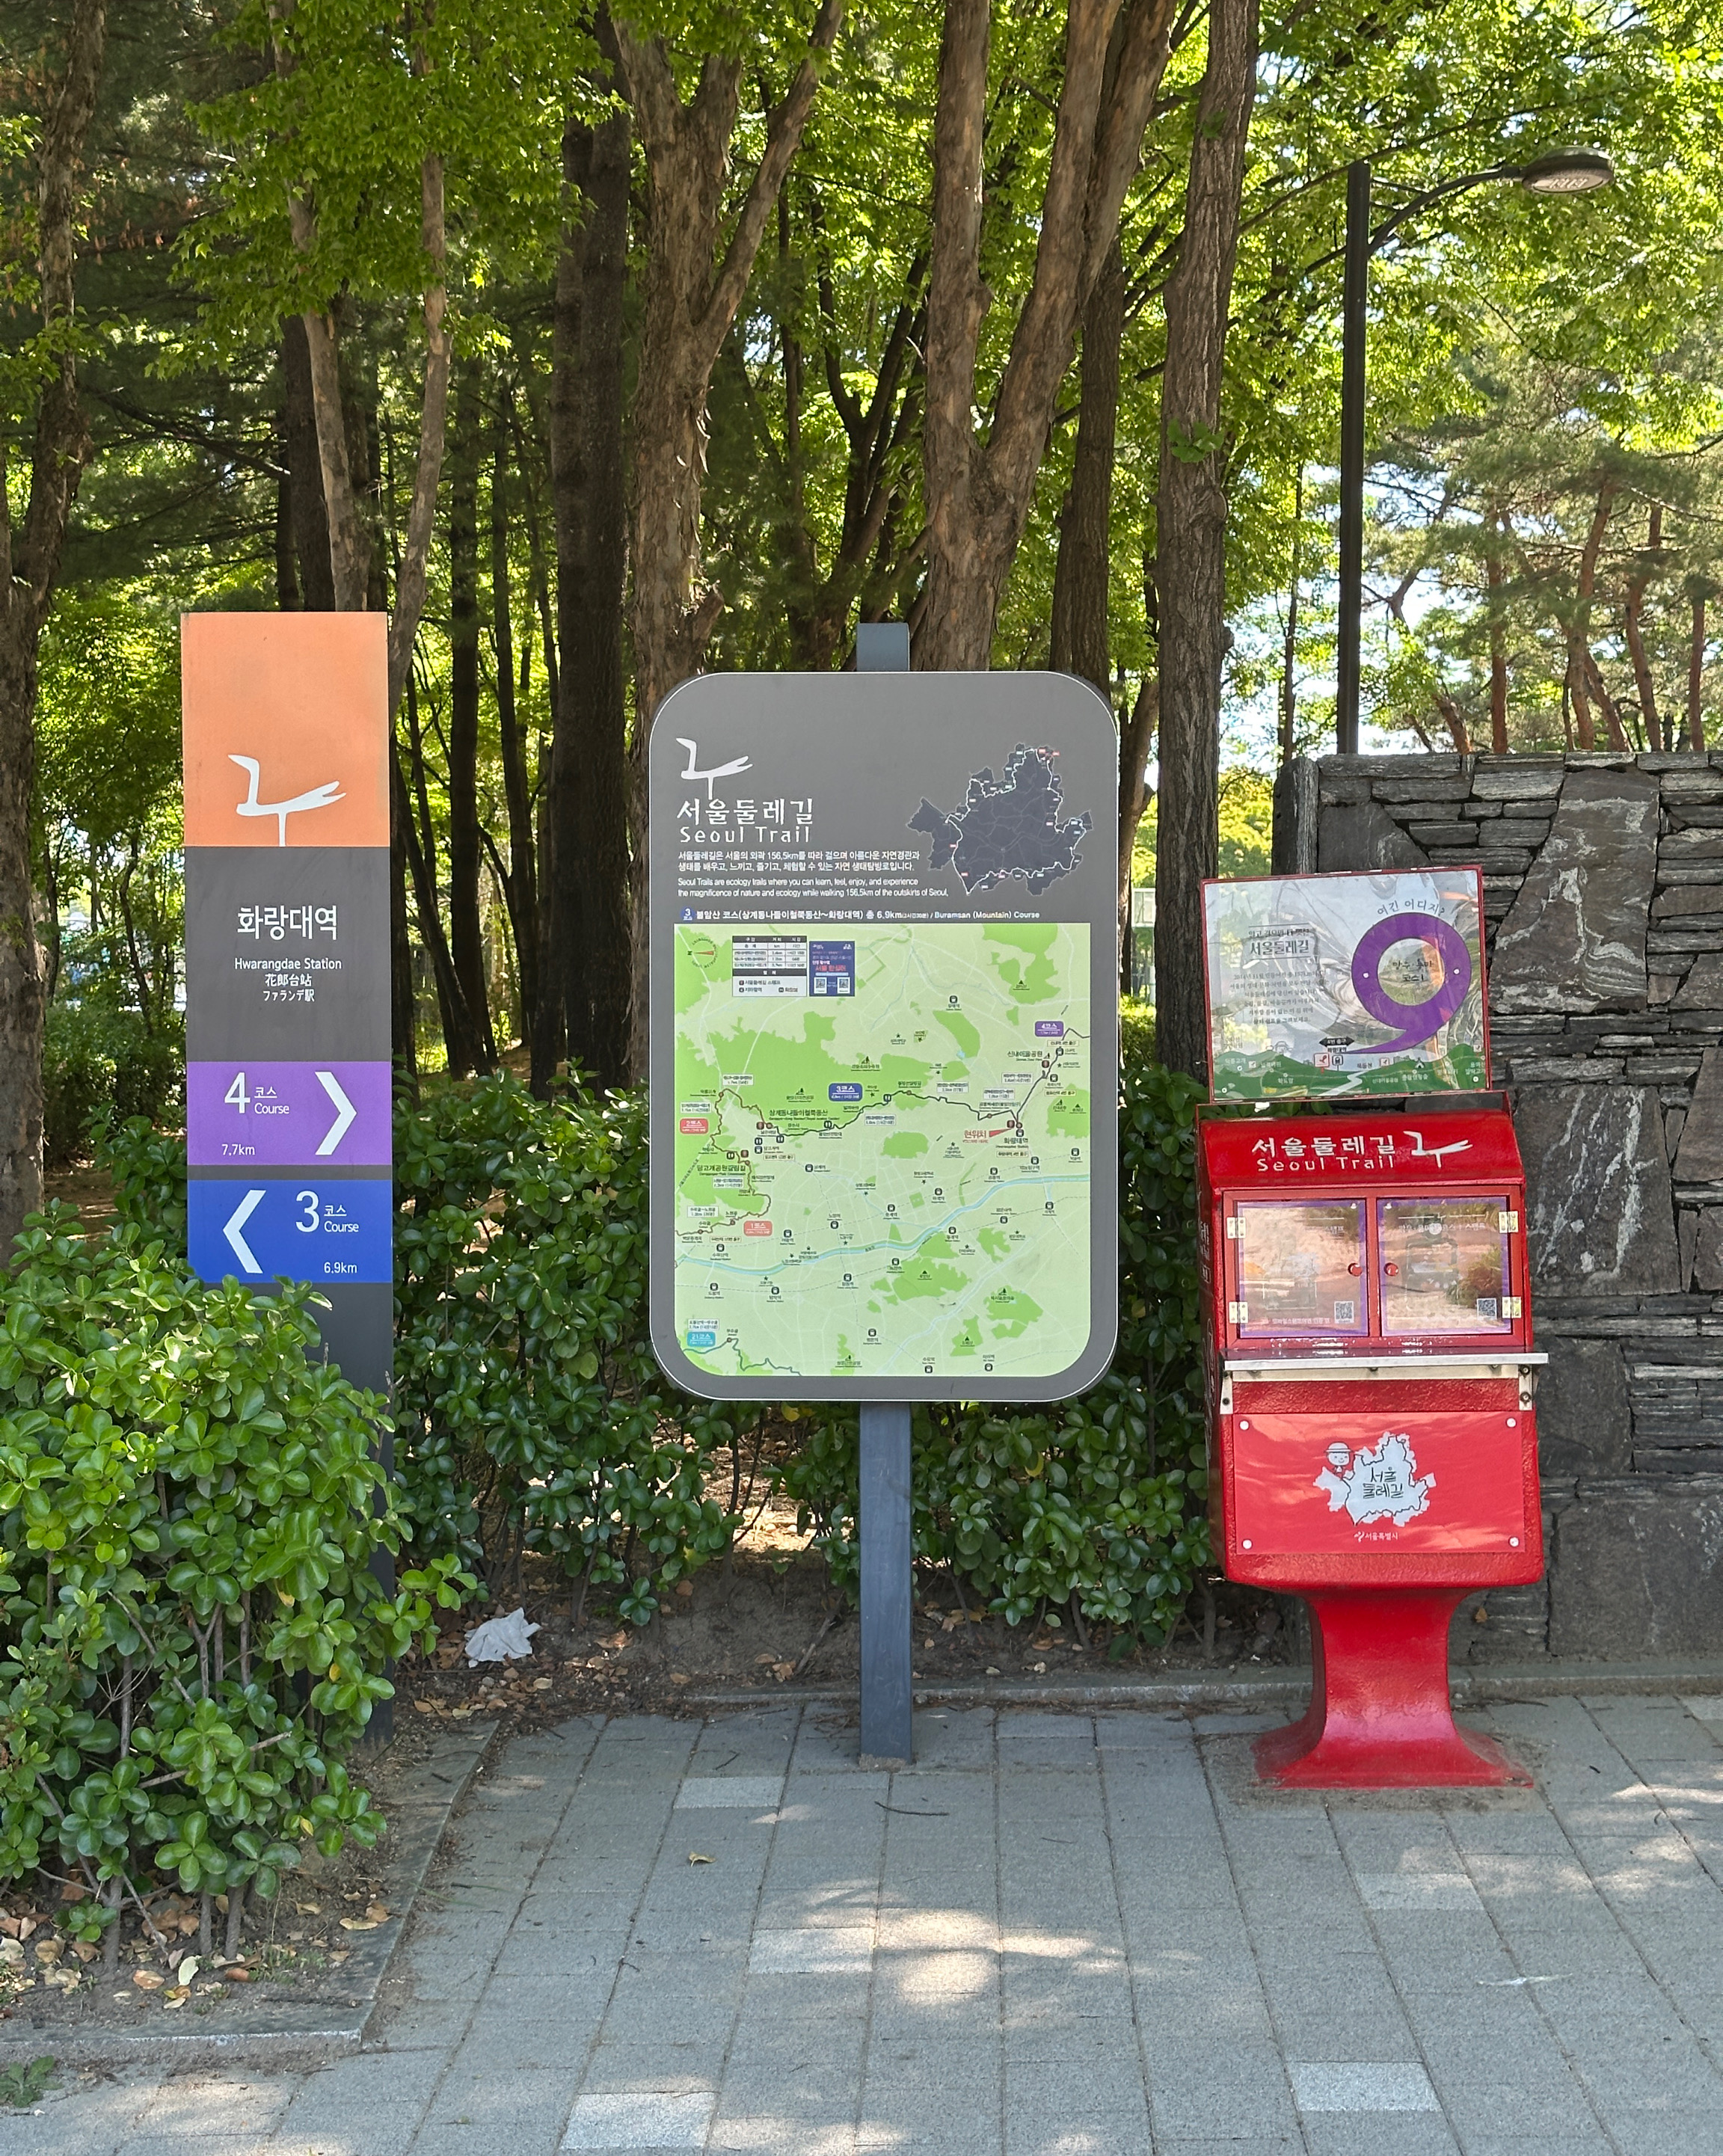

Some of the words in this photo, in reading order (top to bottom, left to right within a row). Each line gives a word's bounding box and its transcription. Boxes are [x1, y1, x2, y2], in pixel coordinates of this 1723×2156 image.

[677, 798, 813, 826] 서울둘레길
[680, 826, 744, 843] Seoul
[755, 826, 811, 843] Trail
[678, 850, 723, 860] 서울둘레길은
[725, 850, 748, 860] 서울의
[750, 850, 765, 860] 외곽
[808, 850, 823, 860] 따라
[825, 850, 847, 860] 걸으며
[850, 850, 879, 860] 아름다운
[881, 850, 920, 860] 자연경관과
[678, 862, 701, 871] 생태를
[703, 862, 728, 871] 배우고,
[730, 862, 755, 871] 느끼고,
[808, 862, 816, 871] 수
[817, 862, 833, 871] 있는
[835, 862, 850, 871] 자연
[678, 877, 695, 887] Seoul
[697, 877, 713, 887] Trails
[714, 877, 725, 887] are
[726, 877, 751, 887] ecology
[752, 877, 767, 887] trails
[768, 877, 787, 887] where
[788, 877, 801, 887] you
[802, 877, 814, 887] can
[815, 877, 833, 887] learn,
[834, 877, 847, 887] feel,
[848, 877, 867, 887] enjoy,
[869, 877, 882, 887] and
[883, 877, 918, 887] experience
[678, 888, 688, 897] the
[689, 888, 732, 897] magnificence
[733, 888, 740, 897] of
[740, 888, 761, 897] nature
[761, 888, 774, 897] and
[775, 888, 800, 897] ecology
[802, 888, 819, 897] while
[820, 888, 844, 897] walking
[874, 888, 881, 897] of
[882, 888, 892, 897] the
[893, 888, 920, 897] outskirts
[921, 888, 928, 897] of
[685, 908, 691, 916] 3
[1377, 900, 1399, 915] 여긴
[1404, 898, 1446, 917] 어디지?
[935, 911, 971, 919] Buramsan
[973, 910, 1012, 920] (Mountain)
[1013, 911, 1040, 919] Course
[237, 905, 337, 941] 화랑대역
[1250, 939, 1309, 956] 서울둘레길
[234, 957, 301, 971] Hwarangdae
[304, 957, 343, 970] Station
[265, 974, 312, 987] 花郎台站
[262, 989, 315, 1002] ファランデ駅
[224, 1072, 251, 1114] 4
[254, 1087, 277, 1099] 코스
[254, 1102, 290, 1114] Course
[963, 1130, 986, 1139] 현위치
[221, 1143, 256, 1156] 7.7km
[1251, 1134, 1396, 1158] 서울둘레길
[1256, 1157, 1325, 1172] Seoul
[1336, 1155, 1394, 1170] Trail
[295, 1190, 321, 1232] 3
[324, 1205, 347, 1217] 코스
[324, 1220, 359, 1232] Course
[324, 1262, 357, 1274] 6.9km
[1371, 1466, 1396, 1483] 서울
[1363, 1483, 1404, 1499] 둘레길
[1365, 1532, 1398, 1541] 서울특별시
